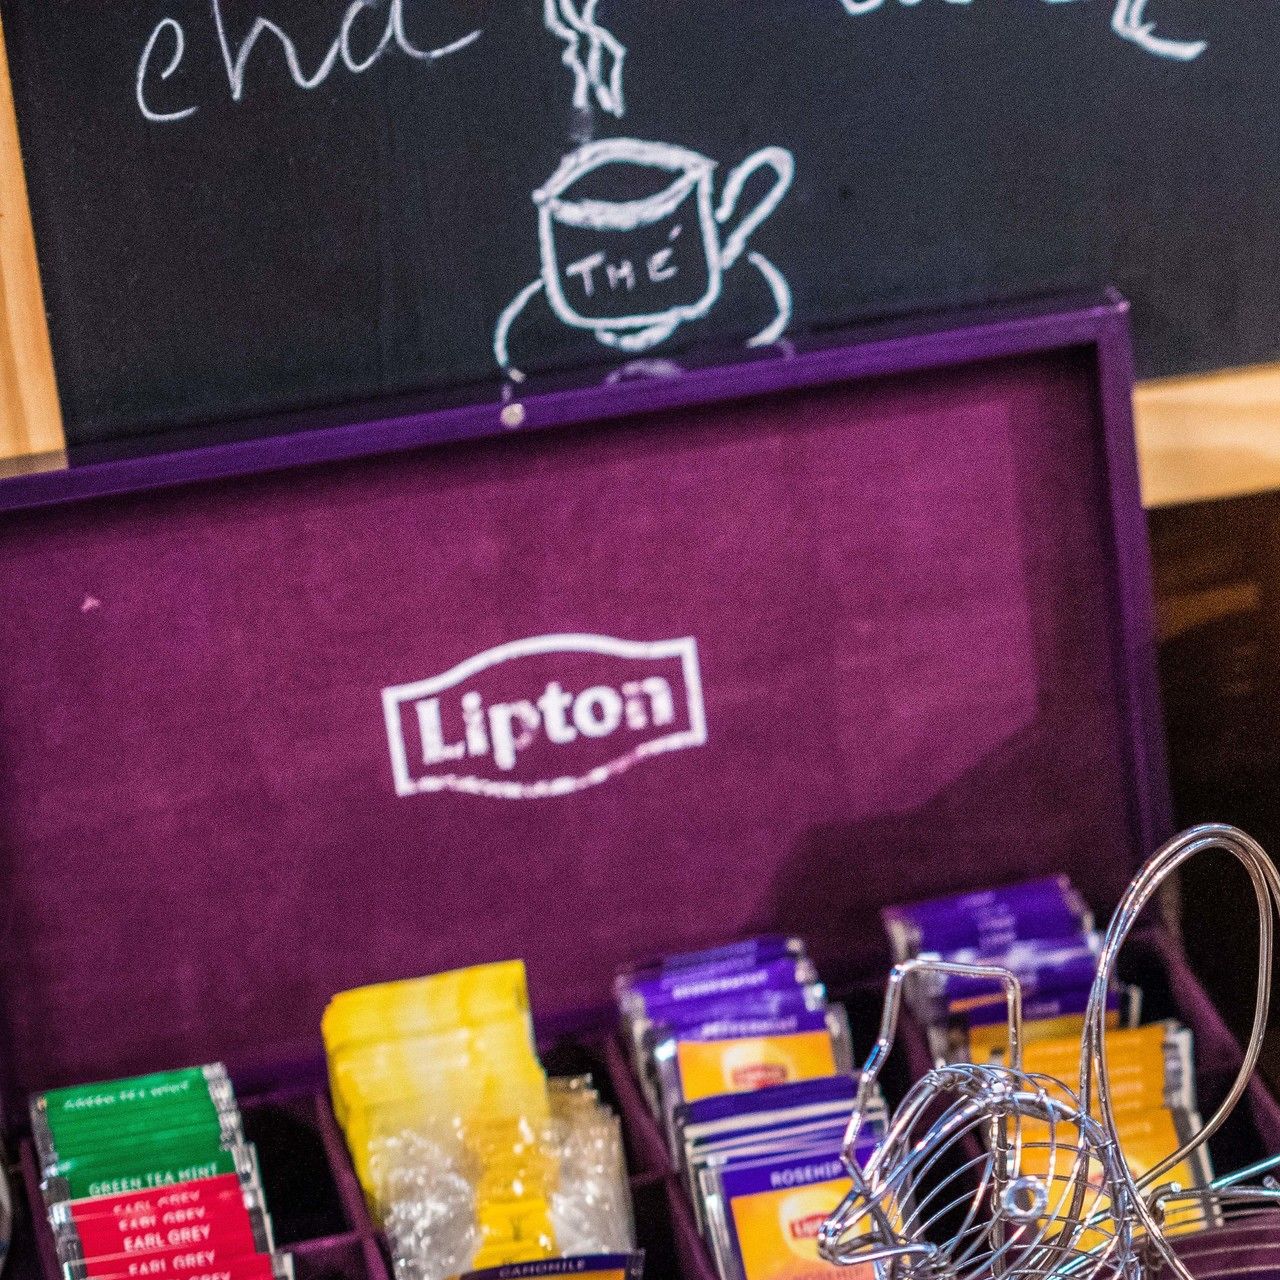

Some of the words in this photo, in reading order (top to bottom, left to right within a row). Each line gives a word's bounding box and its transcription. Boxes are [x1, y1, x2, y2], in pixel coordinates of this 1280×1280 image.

[415, 676, 674, 771] Lipton
[89, 1175, 142, 1197] GREEN
[147, 1170, 175, 1188] TEA
[178, 1162, 218, 1182] MINT
[770, 1160, 843, 1188] ROSEHIP
[123, 1232, 165, 1252] EARL
[167, 1223, 211, 1246] GREY
[499, 1259, 586, 1279] CAMOMILE
